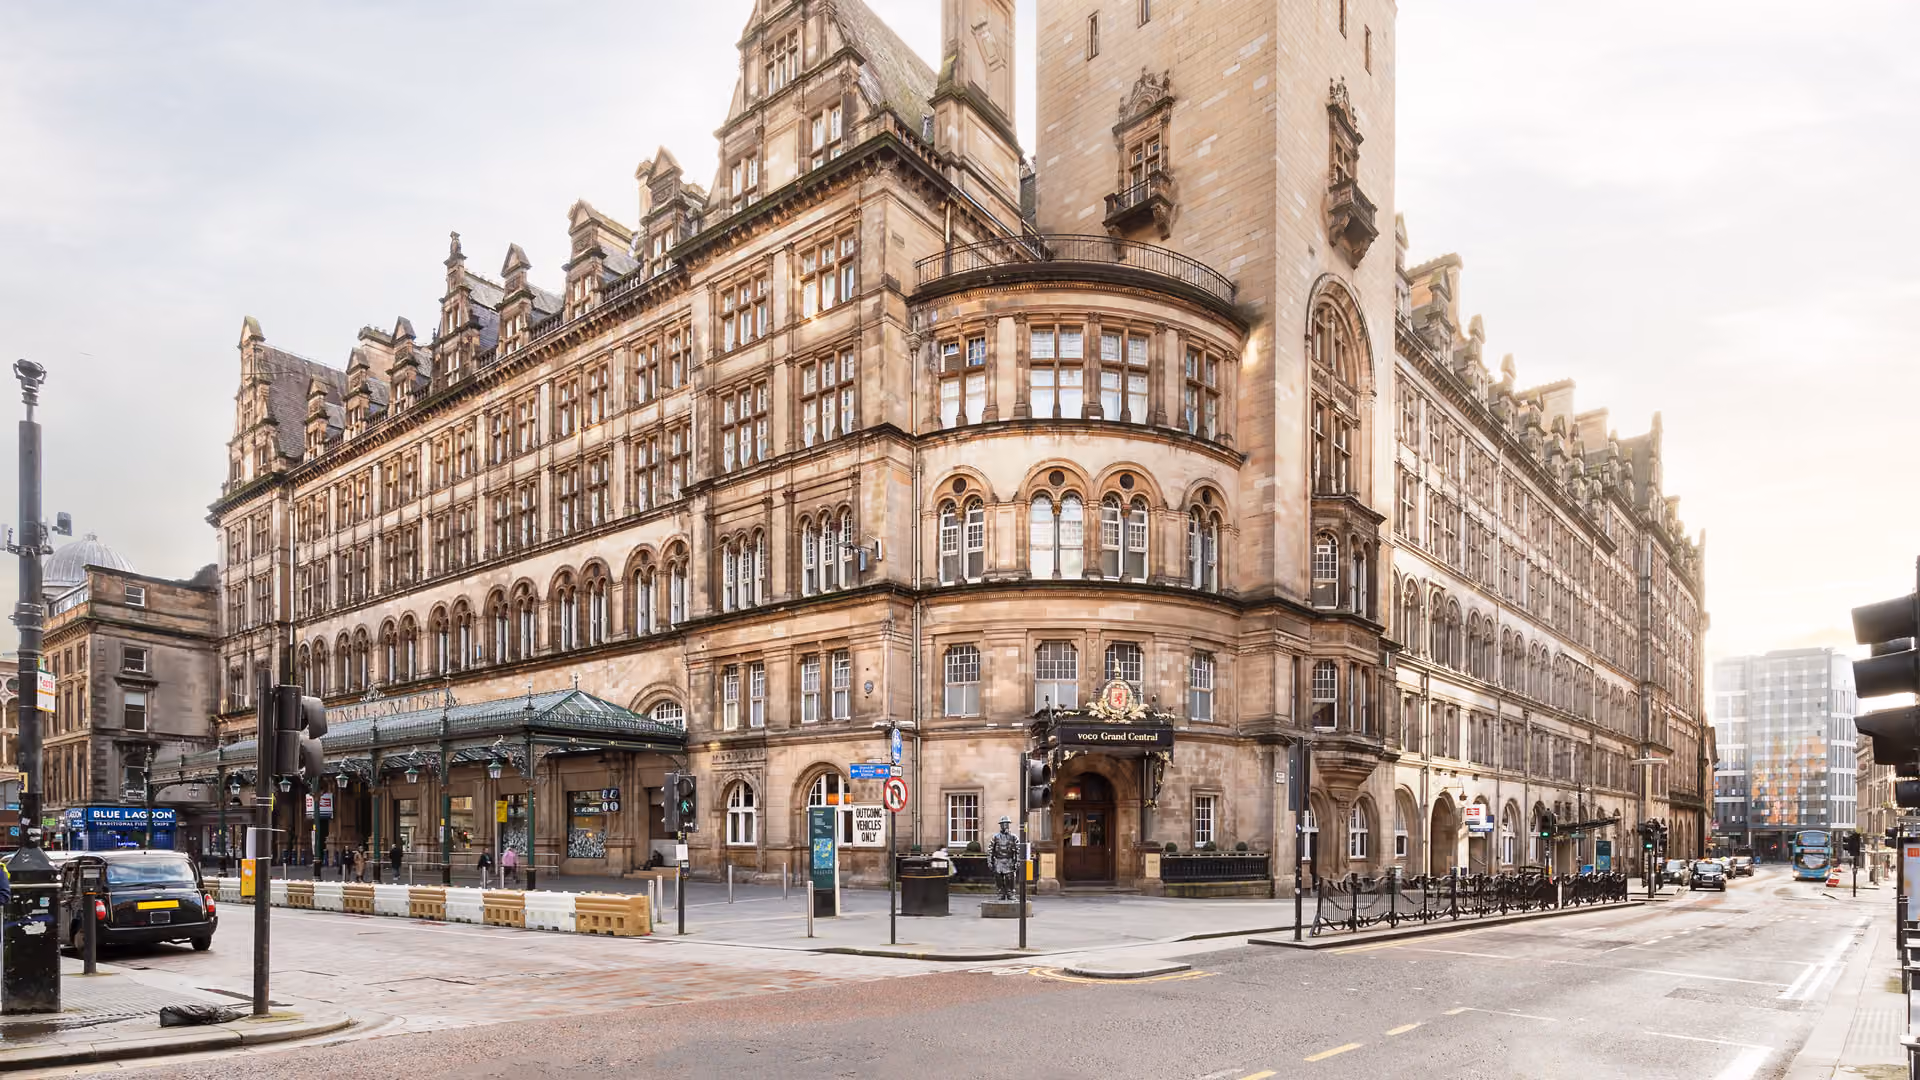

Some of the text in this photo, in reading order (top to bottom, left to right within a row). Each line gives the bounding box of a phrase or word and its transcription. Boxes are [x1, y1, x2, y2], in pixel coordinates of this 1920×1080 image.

[1100, 732, 1127, 741] Grand
[1128, 732, 1158, 741] Central
[93, 810, 120, 819] BLUE
[856, 808, 882, 818] OUTGOING
[856, 820, 881, 831] VEHICLES
[861, 832, 876, 842] ONLY
